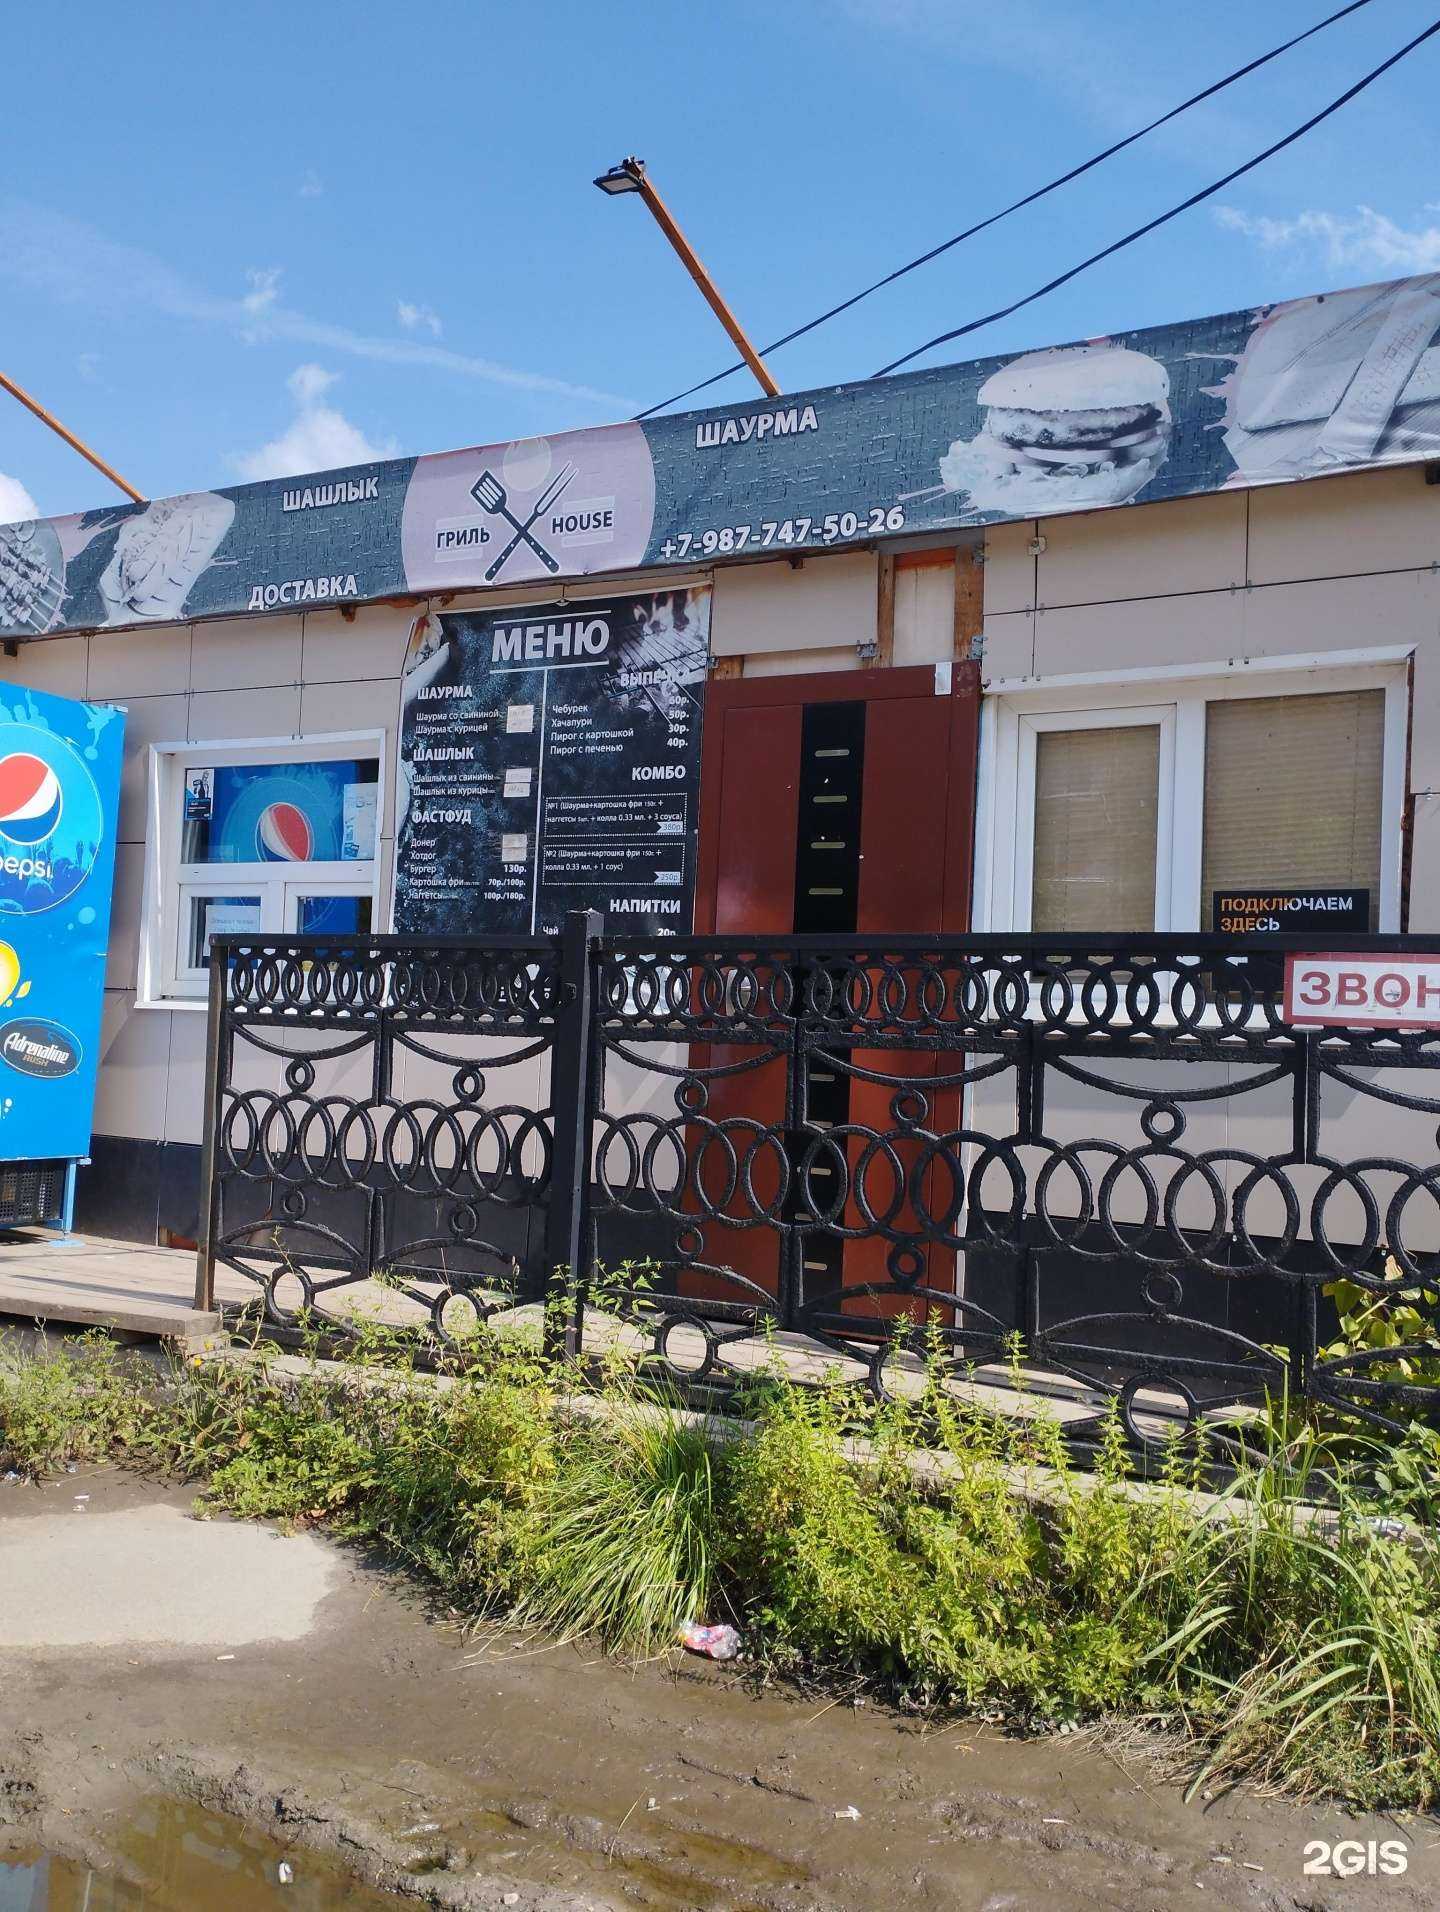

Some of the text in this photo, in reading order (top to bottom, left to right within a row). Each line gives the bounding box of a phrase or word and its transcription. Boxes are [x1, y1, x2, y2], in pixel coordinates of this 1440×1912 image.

[695, 405, 818, 448] ШАУРМА
[282, 476, 380, 512] ШАШЛЫК
[552, 510, 613, 534] HOUSE
[437, 528, 490, 548] ГРИЛЬ
[660, 505, 905, 559] +7-987-747-50-26
[247, 574, 358, 610] ДОСТАВКА
[491, 619, 610, 663] МЕНЮ
[417, 685, 473, 700] ШАУРМА
[416, 711, 447, 723] Шаурма
[448, 712, 459, 720] со
[460, 709, 499, 720] свининой
[552, 704, 588, 716] Чебурек
[669, 709, 690, 721] 50р.
[415, 725, 447, 736] Шаурма
[454, 723, 488, 736] курицей
[551, 718, 592, 729] Хачапури
[550, 728, 634, 743] Пирог с картошкой
[550, 744, 624, 756] Пирог с печенью
[666, 738, 688, 749] 40р.
[413, 747, 475, 761] ШАШЛЫК
[413, 774, 447, 783] Шашлык
[458, 773, 494, 782] свинины
[631, 764, 686, 781] КОМБО
[413, 787, 446, 796] Шашлык
[447, 787, 457, 795] из
[458, 786, 488, 798] курицы
[628, 799, 643, 810] фри
[412, 809, 472, 825] ФАСТФУД
[411, 838, 436, 849] Донер
[410, 852, 436, 862] Хотдог
[626, 849, 640, 859] фри
[410, 864, 527, 875] Бургер 130р.
[409, 878, 447, 888] Картошка
[448, 877, 464, 888] фри
[609, 899, 681, 914] НАПИТКИ
[1220, 896, 1353, 914] ПОДКЛЮЧАЕМ
[542, 925, 559, 936] Чай
[1220, 917, 1280, 933] ЗДЕСЬ
[4, 1032, 70, 1065] Adrenaline
[22, 1054, 49, 1067] RUSH
